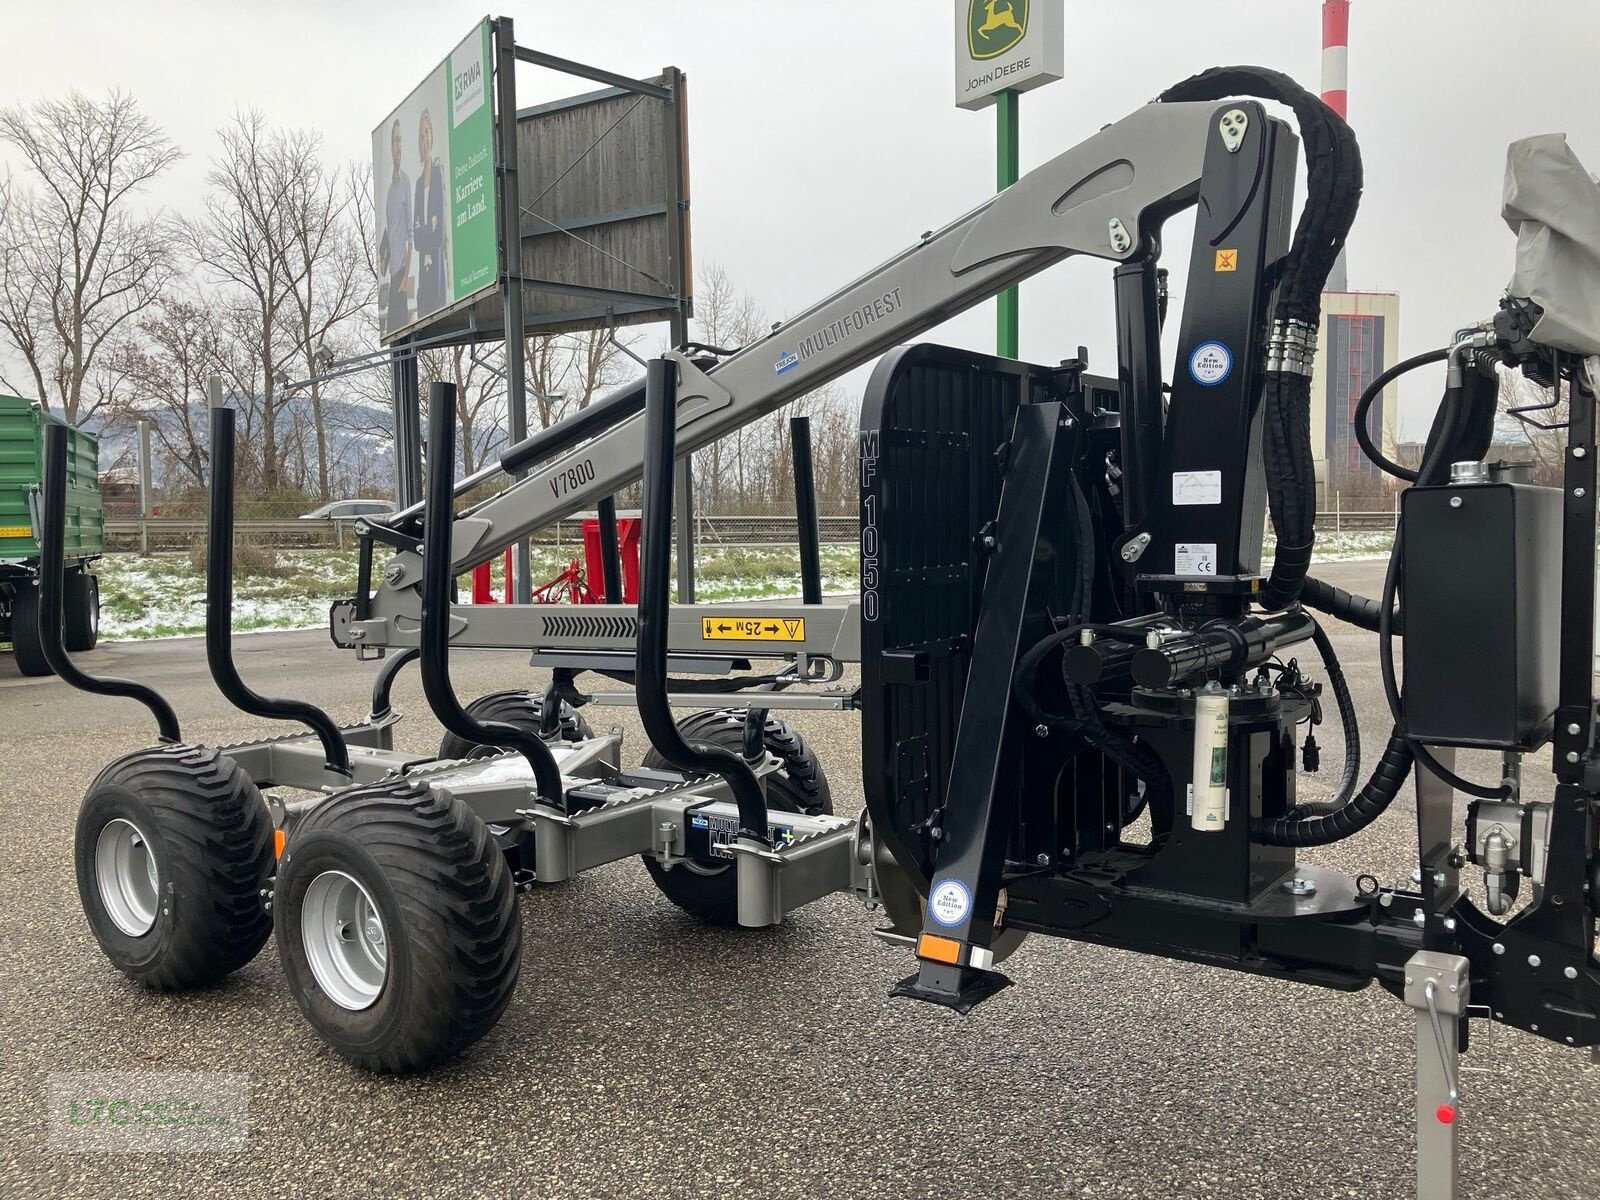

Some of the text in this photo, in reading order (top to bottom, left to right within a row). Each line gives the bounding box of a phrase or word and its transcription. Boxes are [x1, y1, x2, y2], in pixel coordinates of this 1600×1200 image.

[463, 60, 480, 91] RWA
[965, 57, 1031, 92] JOHN DEERE
[455, 162, 468, 179] Deine
[456, 175, 484, 204] Karriere
[456, 194, 487, 228] am Land.
[798, 286, 902, 361] MULTIFOREST
[775, 353, 797, 370] TREJON
[1197, 361, 1224, 369] Edition
[549, 458, 595, 499] V7800
[859, 429, 880, 622] MF 1050
[937, 899, 962, 910] Edition
[943, 895, 959, 904] New
